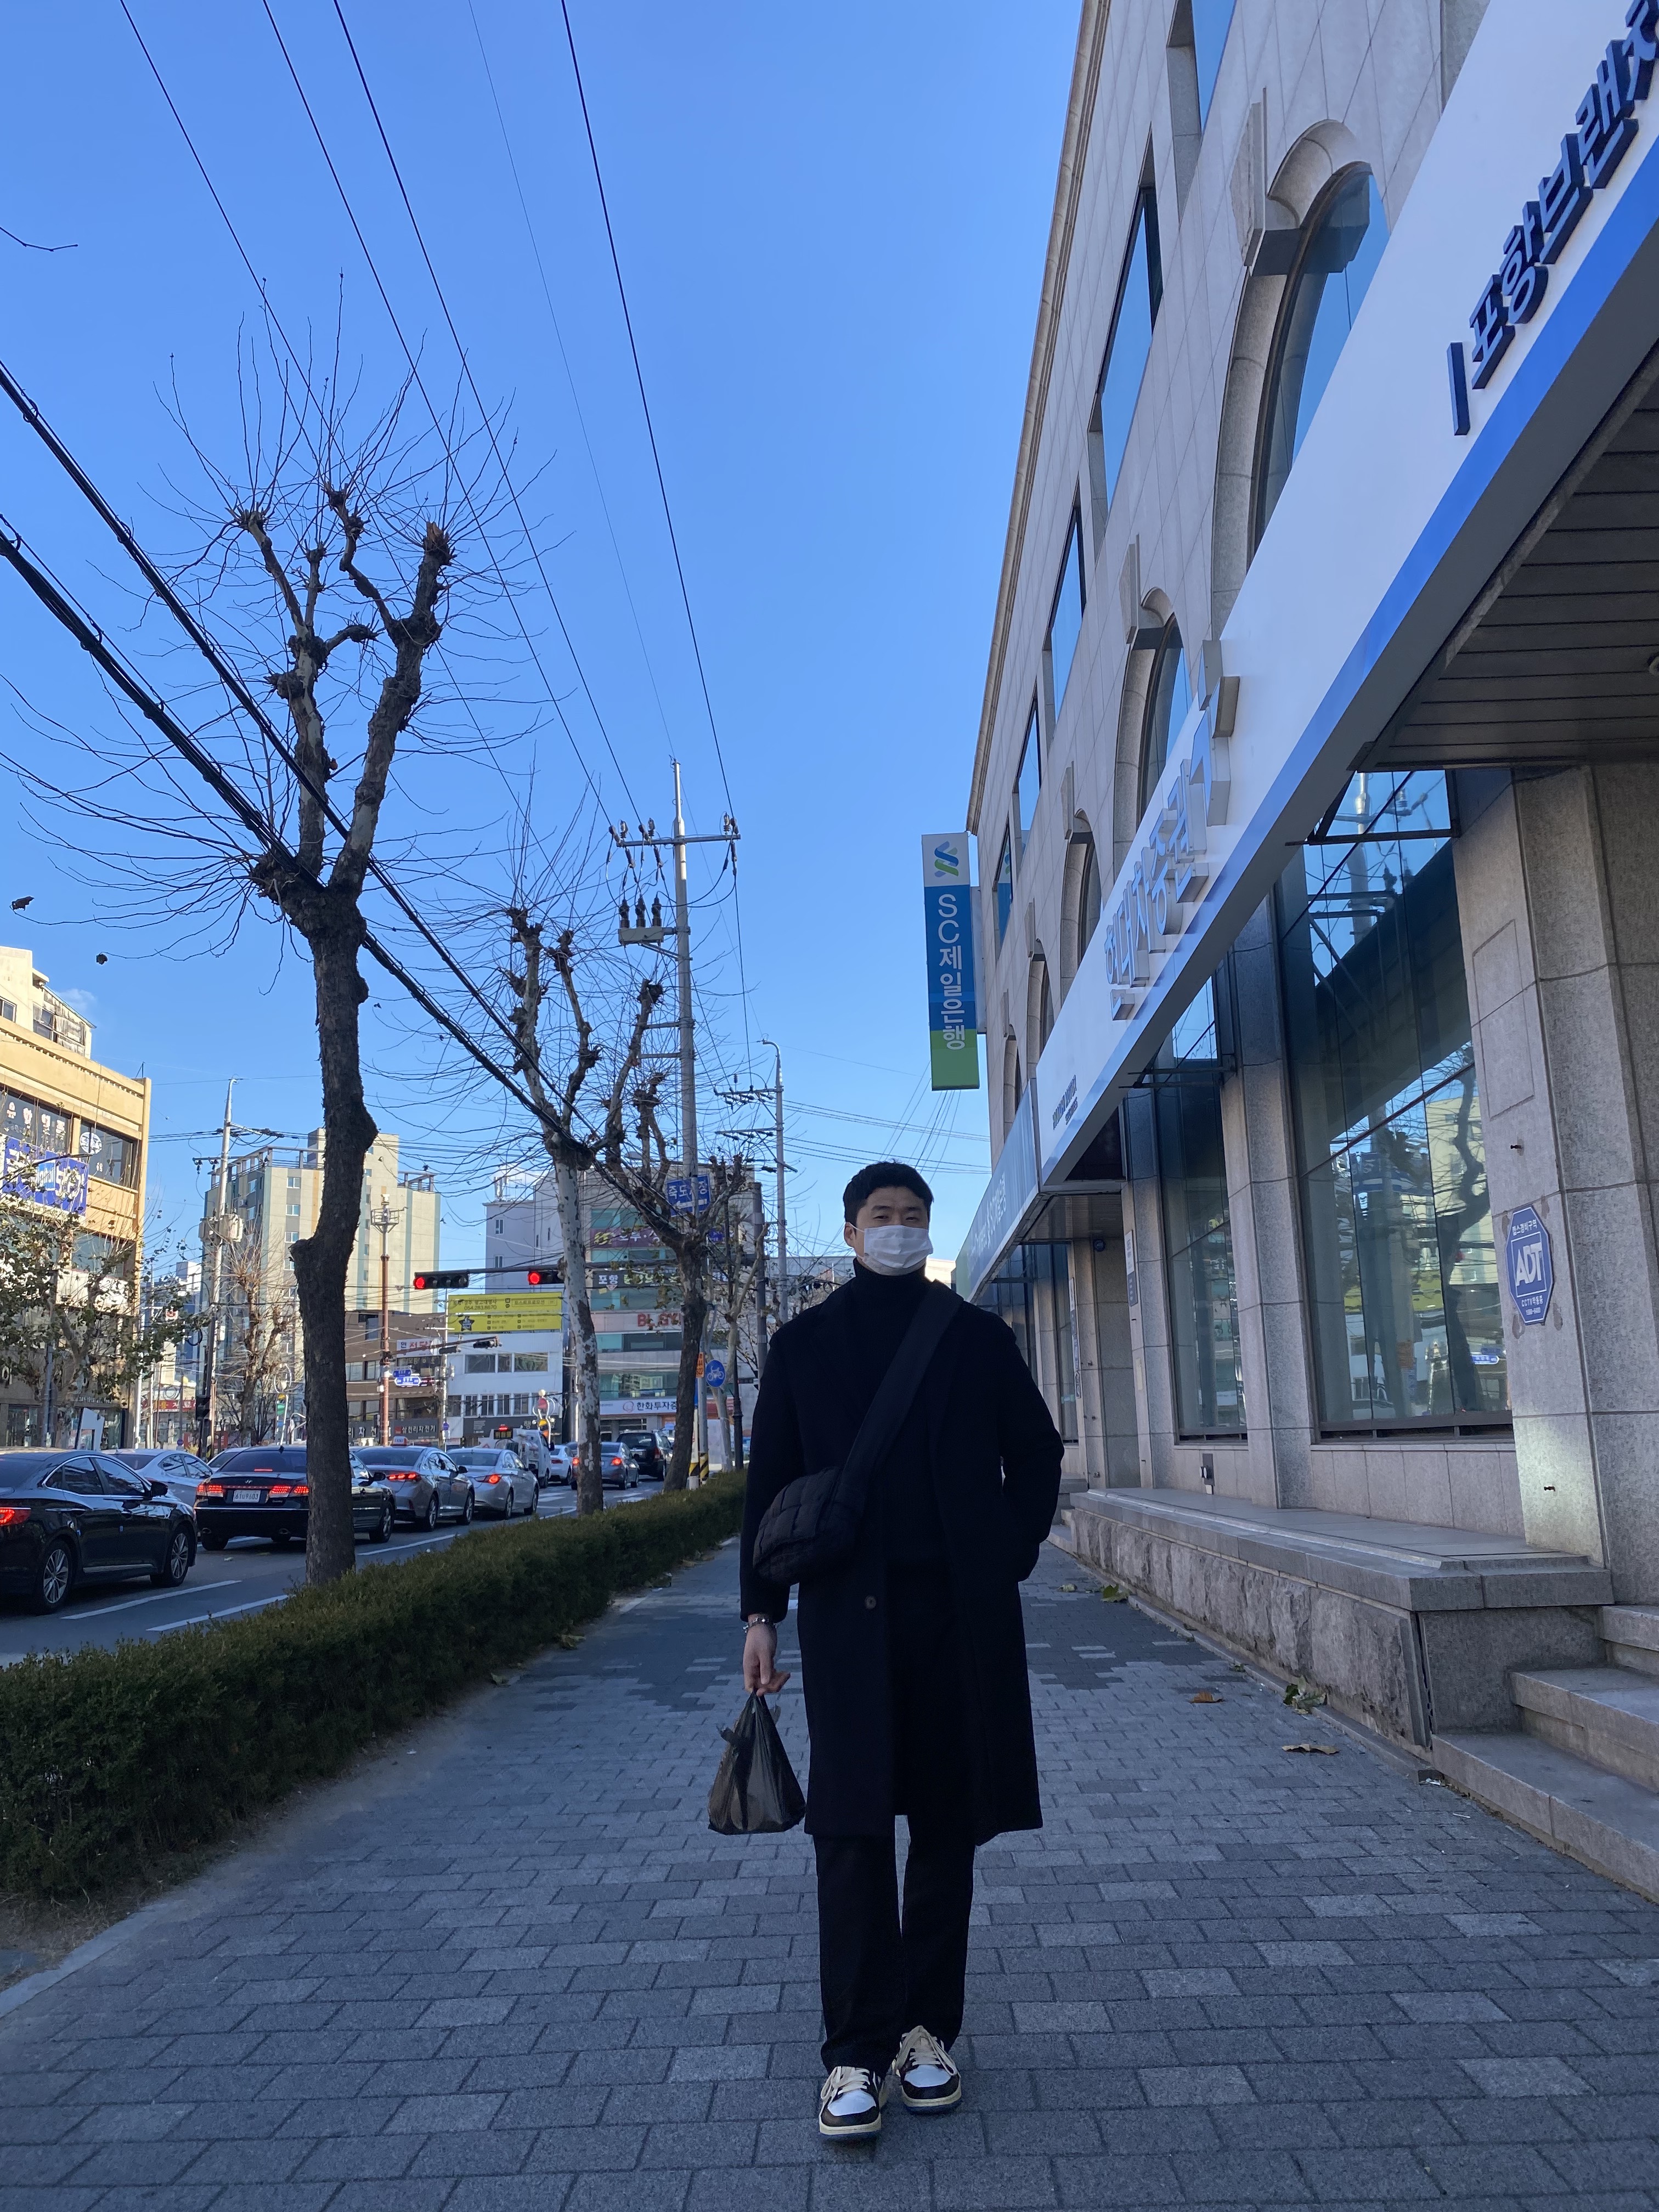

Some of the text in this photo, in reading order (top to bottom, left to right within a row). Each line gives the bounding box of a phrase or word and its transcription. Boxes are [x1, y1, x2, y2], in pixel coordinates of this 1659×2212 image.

[1104, 757, 1209, 1021] 현대차증권
[938, 894, 966, 1051] SC제일은행
[669, 1180, 707, 1200] 죽도장
[599, 1274, 619, 1285] 포항
[1516, 1242, 1543, 1286] ADT
[1521, 1295, 1543, 1307] CCTV작동중
